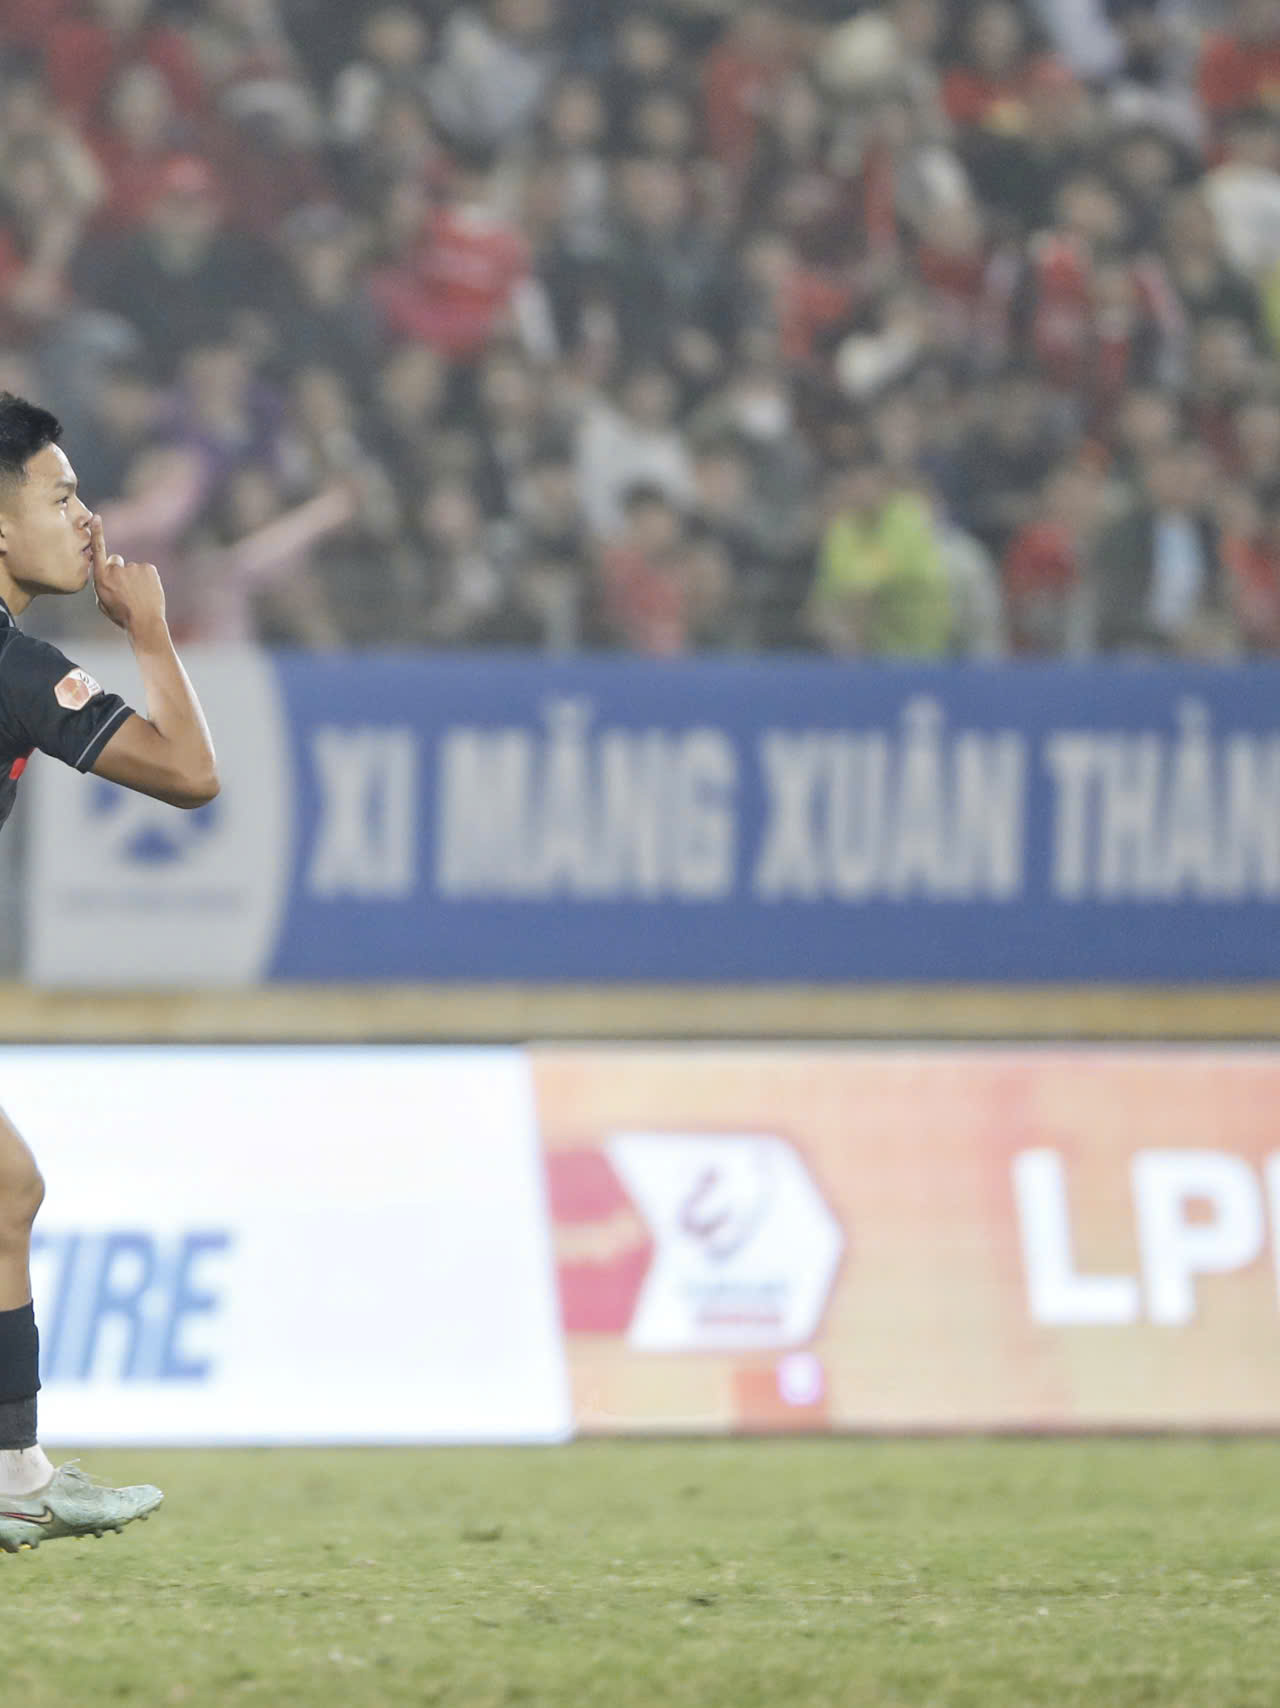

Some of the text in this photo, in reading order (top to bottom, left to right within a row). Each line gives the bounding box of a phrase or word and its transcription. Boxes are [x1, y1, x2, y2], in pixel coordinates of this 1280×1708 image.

[312, 730, 413, 896] XI
[758, 695, 1024, 896] XUÂN
[31, 1229, 229, 1380] IRE
[1012, 1148, 1280, 1322] LP
